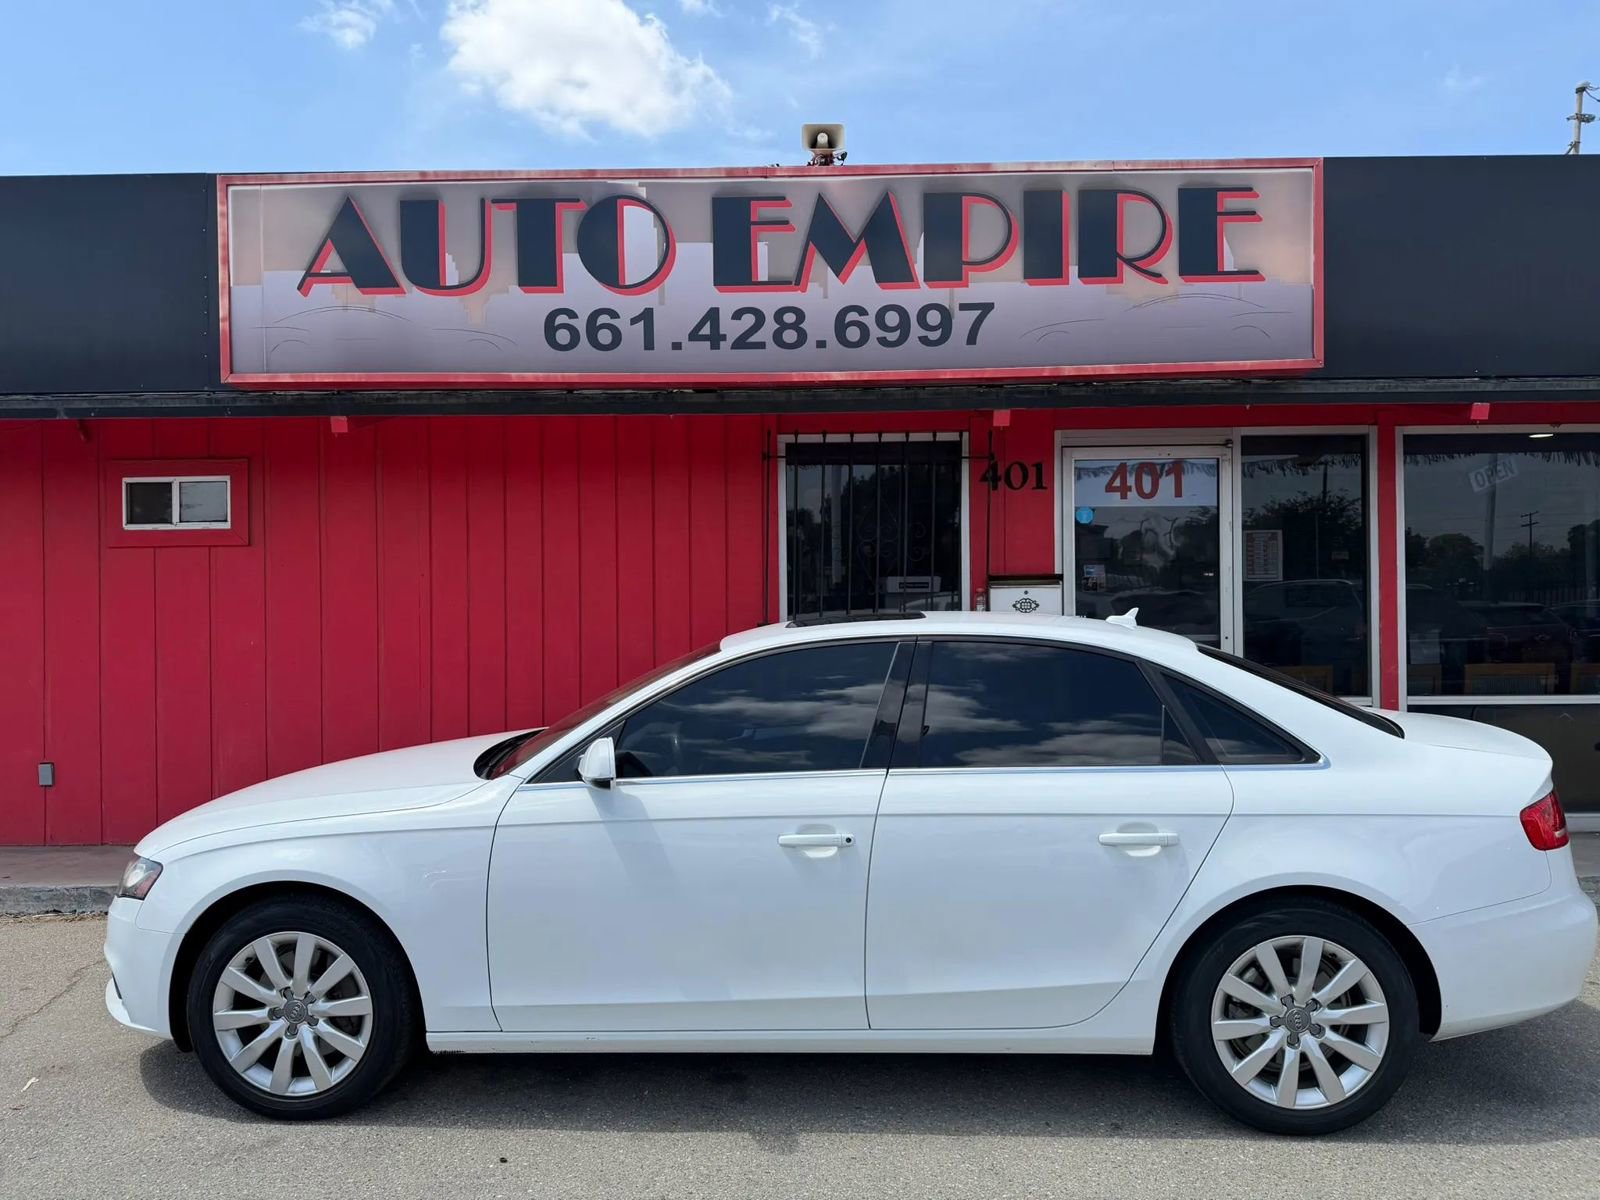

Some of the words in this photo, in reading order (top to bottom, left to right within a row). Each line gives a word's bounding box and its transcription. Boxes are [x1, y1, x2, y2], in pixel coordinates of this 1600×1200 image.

[297, 194, 677, 297] AUTO
[712, 186, 1266, 293] EMPIRE
[543, 302, 995, 352] 661.428.6997
[979, 460, 1048, 491] 401
[1105, 459, 1187, 500] 401
[1474, 459, 1515, 487] OPEN
